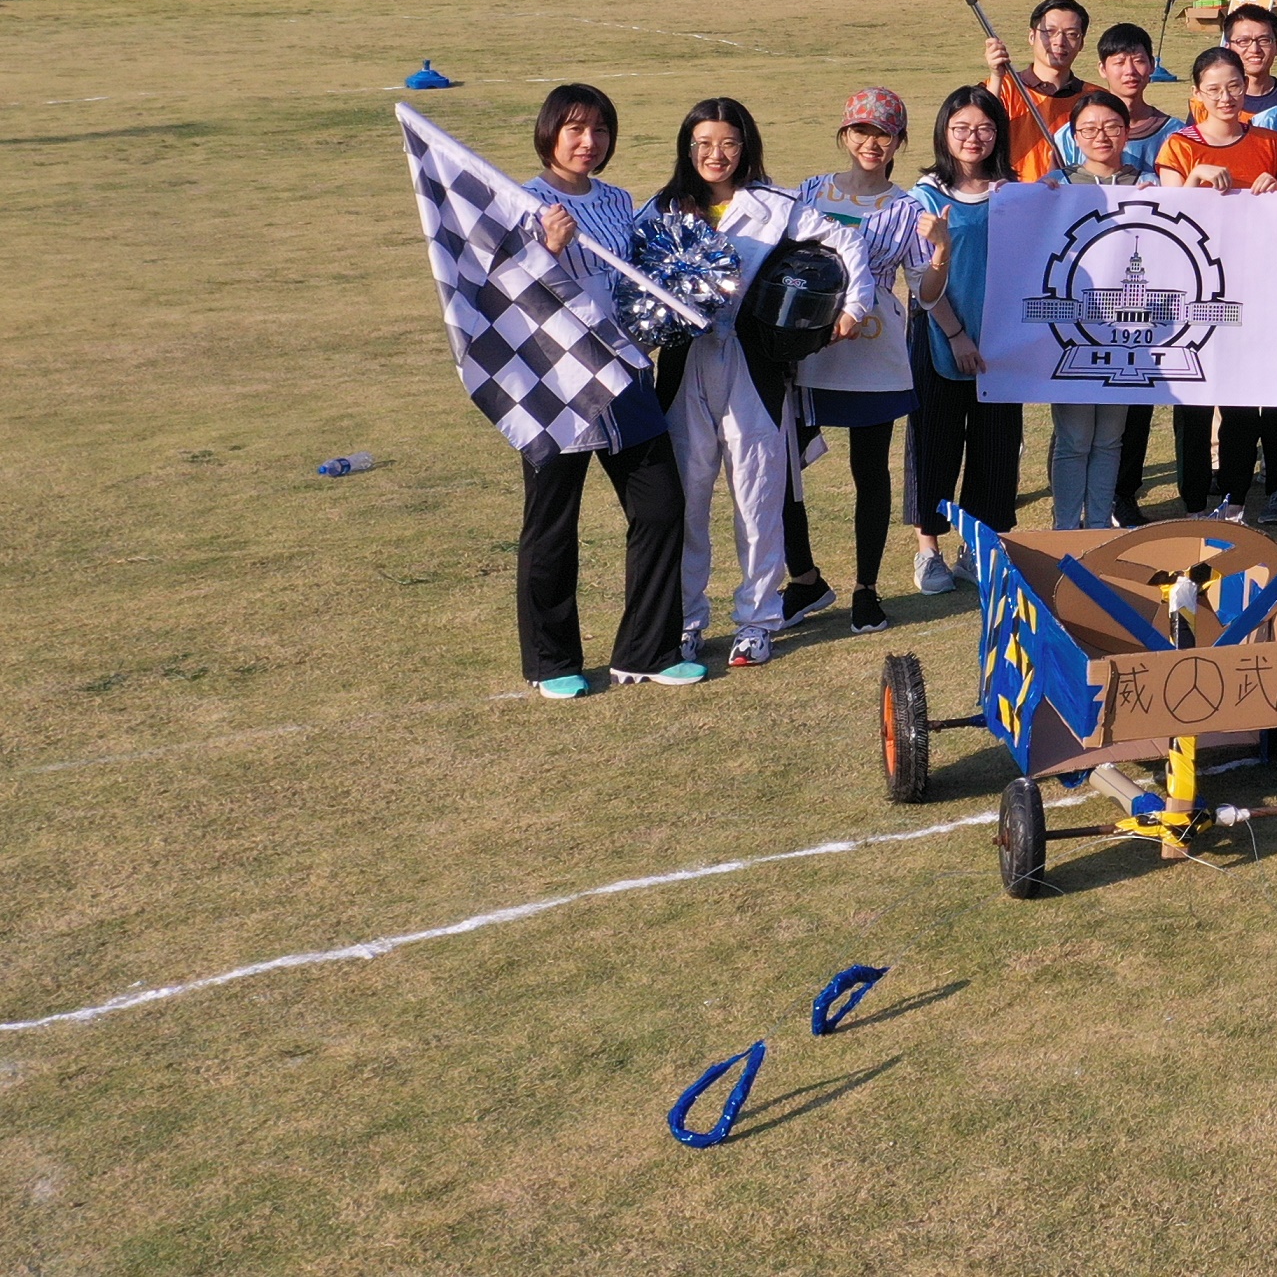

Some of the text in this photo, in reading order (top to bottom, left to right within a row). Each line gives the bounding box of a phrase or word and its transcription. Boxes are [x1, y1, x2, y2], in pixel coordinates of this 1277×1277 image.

[1110, 329, 1153, 344] 1920
[1090, 351, 1166, 366] HIT
[1110, 662, 1154, 714] 威
